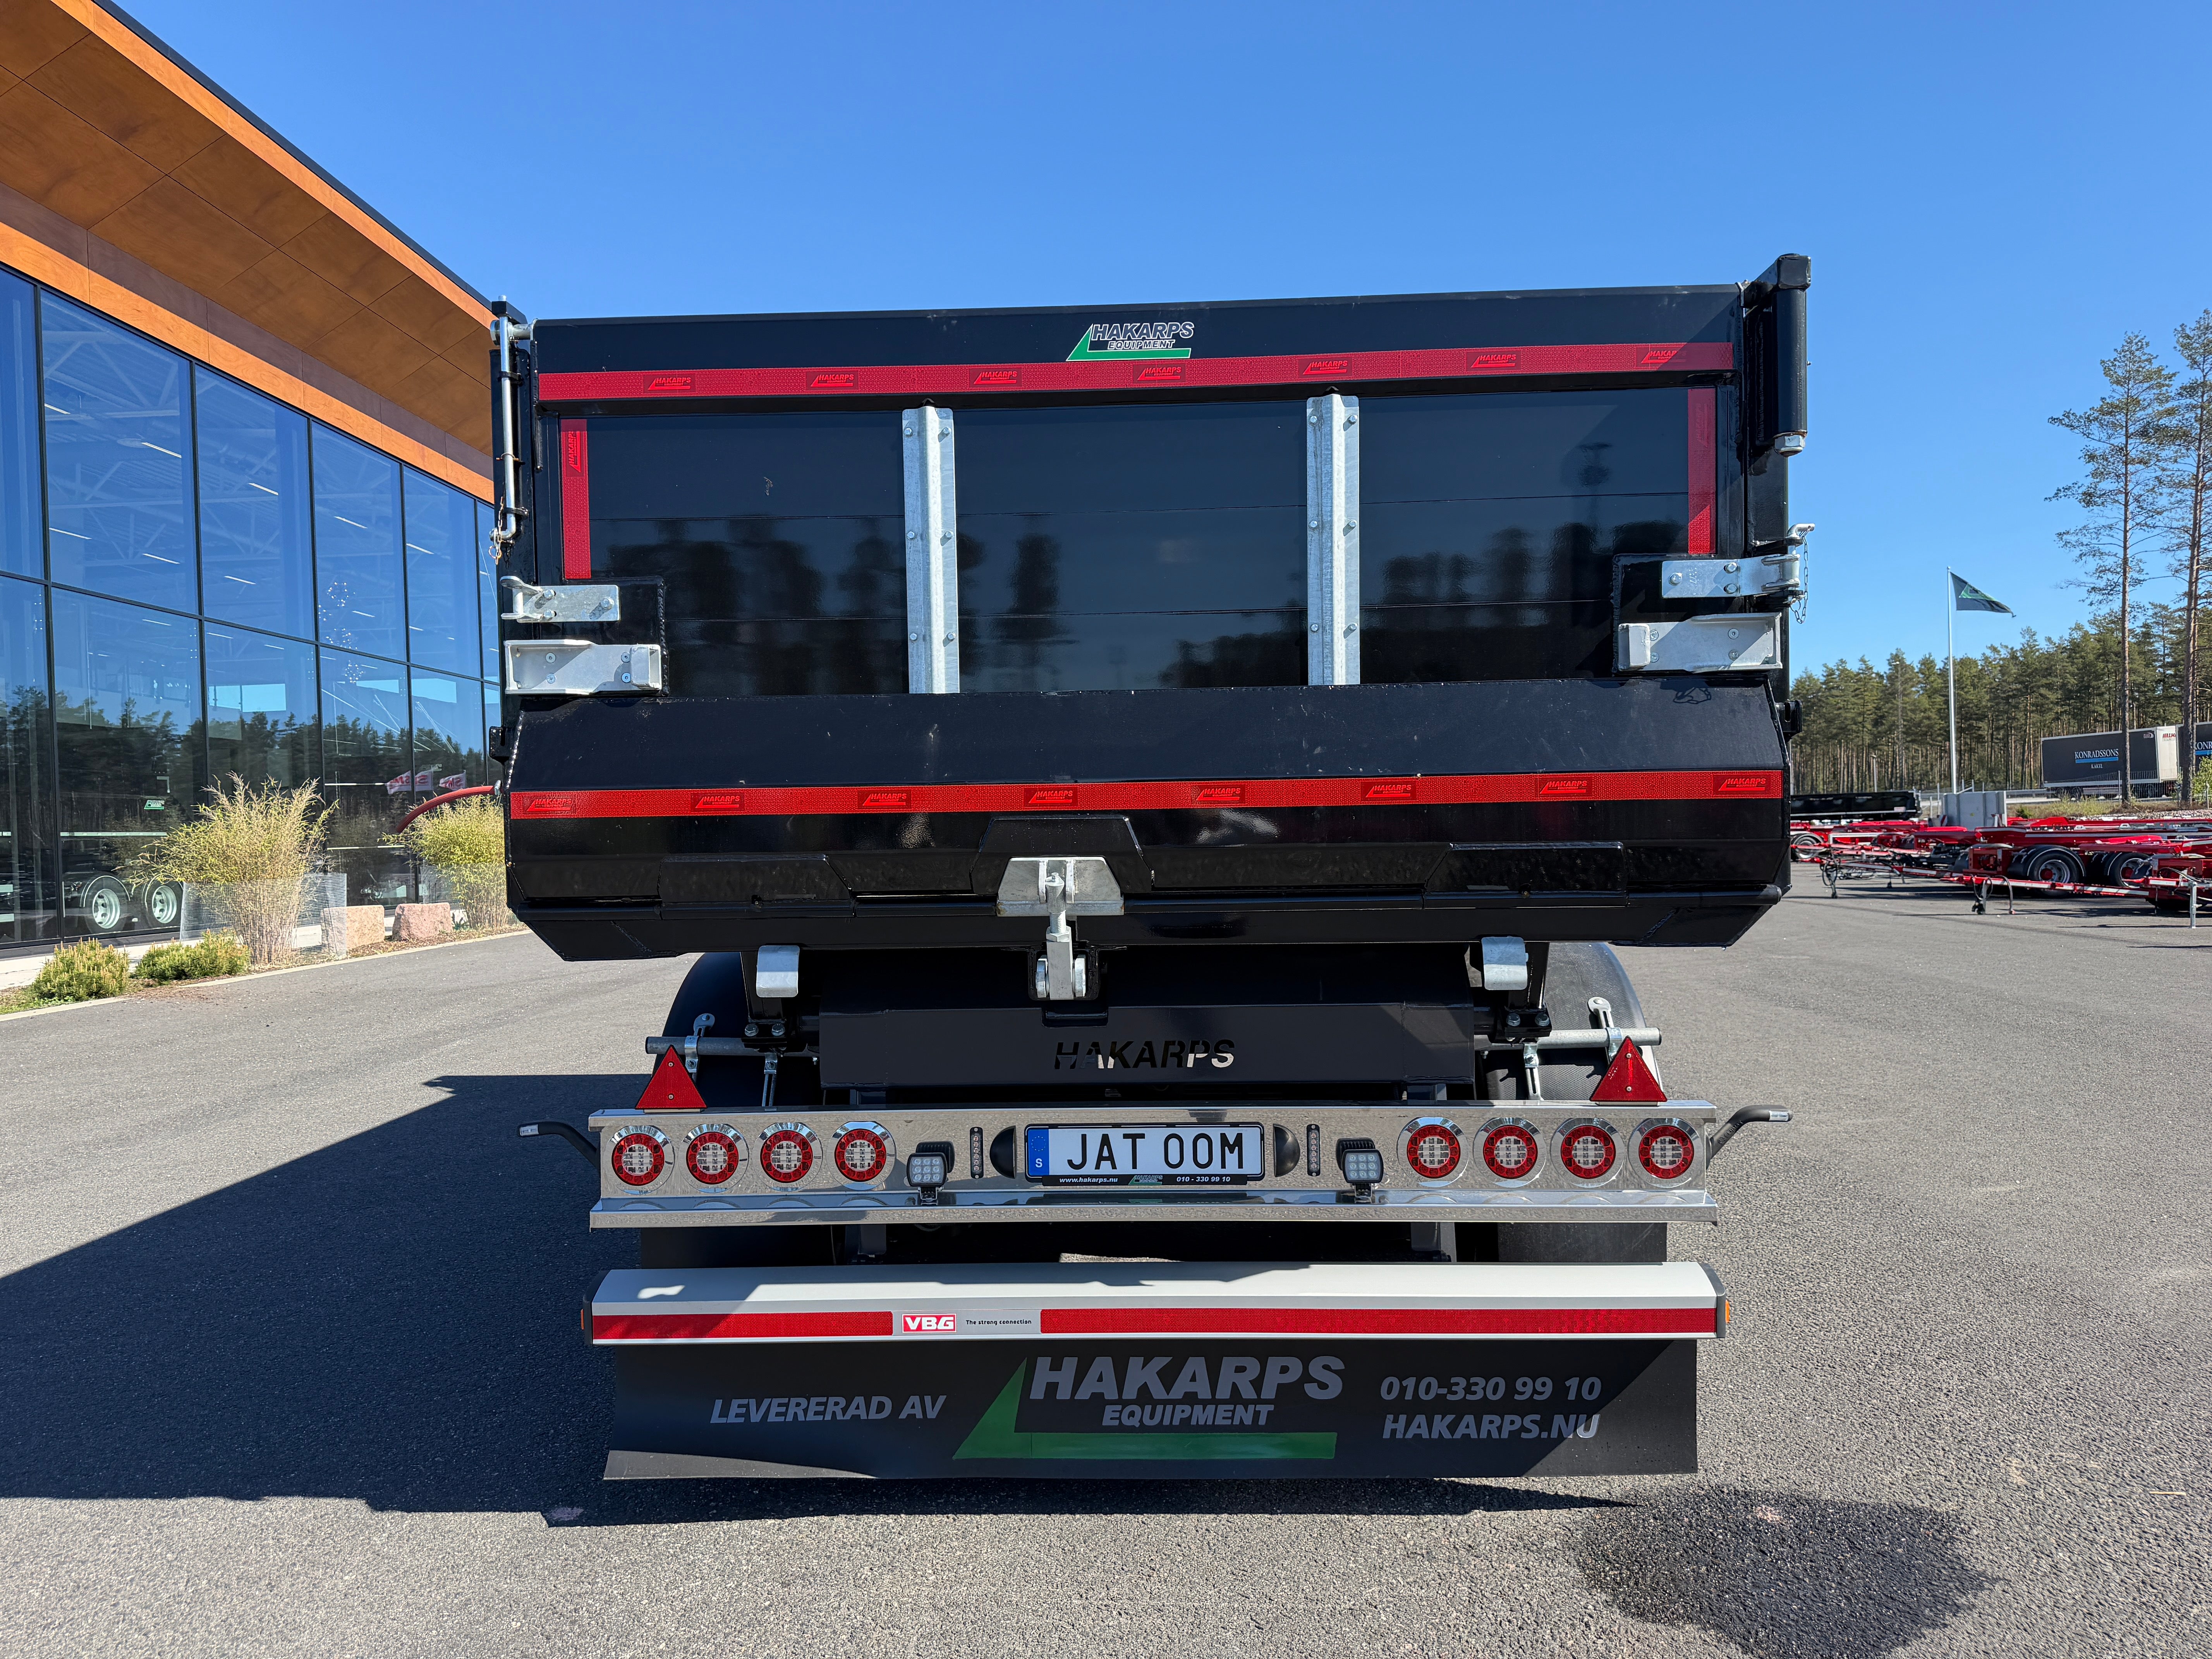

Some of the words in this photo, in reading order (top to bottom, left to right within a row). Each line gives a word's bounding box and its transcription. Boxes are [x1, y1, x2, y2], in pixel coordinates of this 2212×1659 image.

[1092, 322, 1194, 341] HAKARPS
[1108, 339, 1175, 350] EQUIPMENT
[2075, 749, 2119, 759] KONRADSSONS
[1054, 1039, 1235, 1070] HAKARPS
[1035, 1158, 1043, 1168] S
[1067, 1133, 1145, 1170] JAT
[905, 1317, 955, 1330] VBG
[1029, 1356, 1345, 1400] HAKARPS
[1381, 1376, 1506, 1401] 010-330
[1514, 1376, 1553, 1401] 99
[1565, 1376, 1602, 1401] 10
[711, 1395, 892, 1423] LEVERERAD
[899, 1395, 946, 1419] AV
[1102, 1404, 1274, 1427] EQUIPMENT
[1382, 1413, 1601, 1439] HAKARPS.NU
